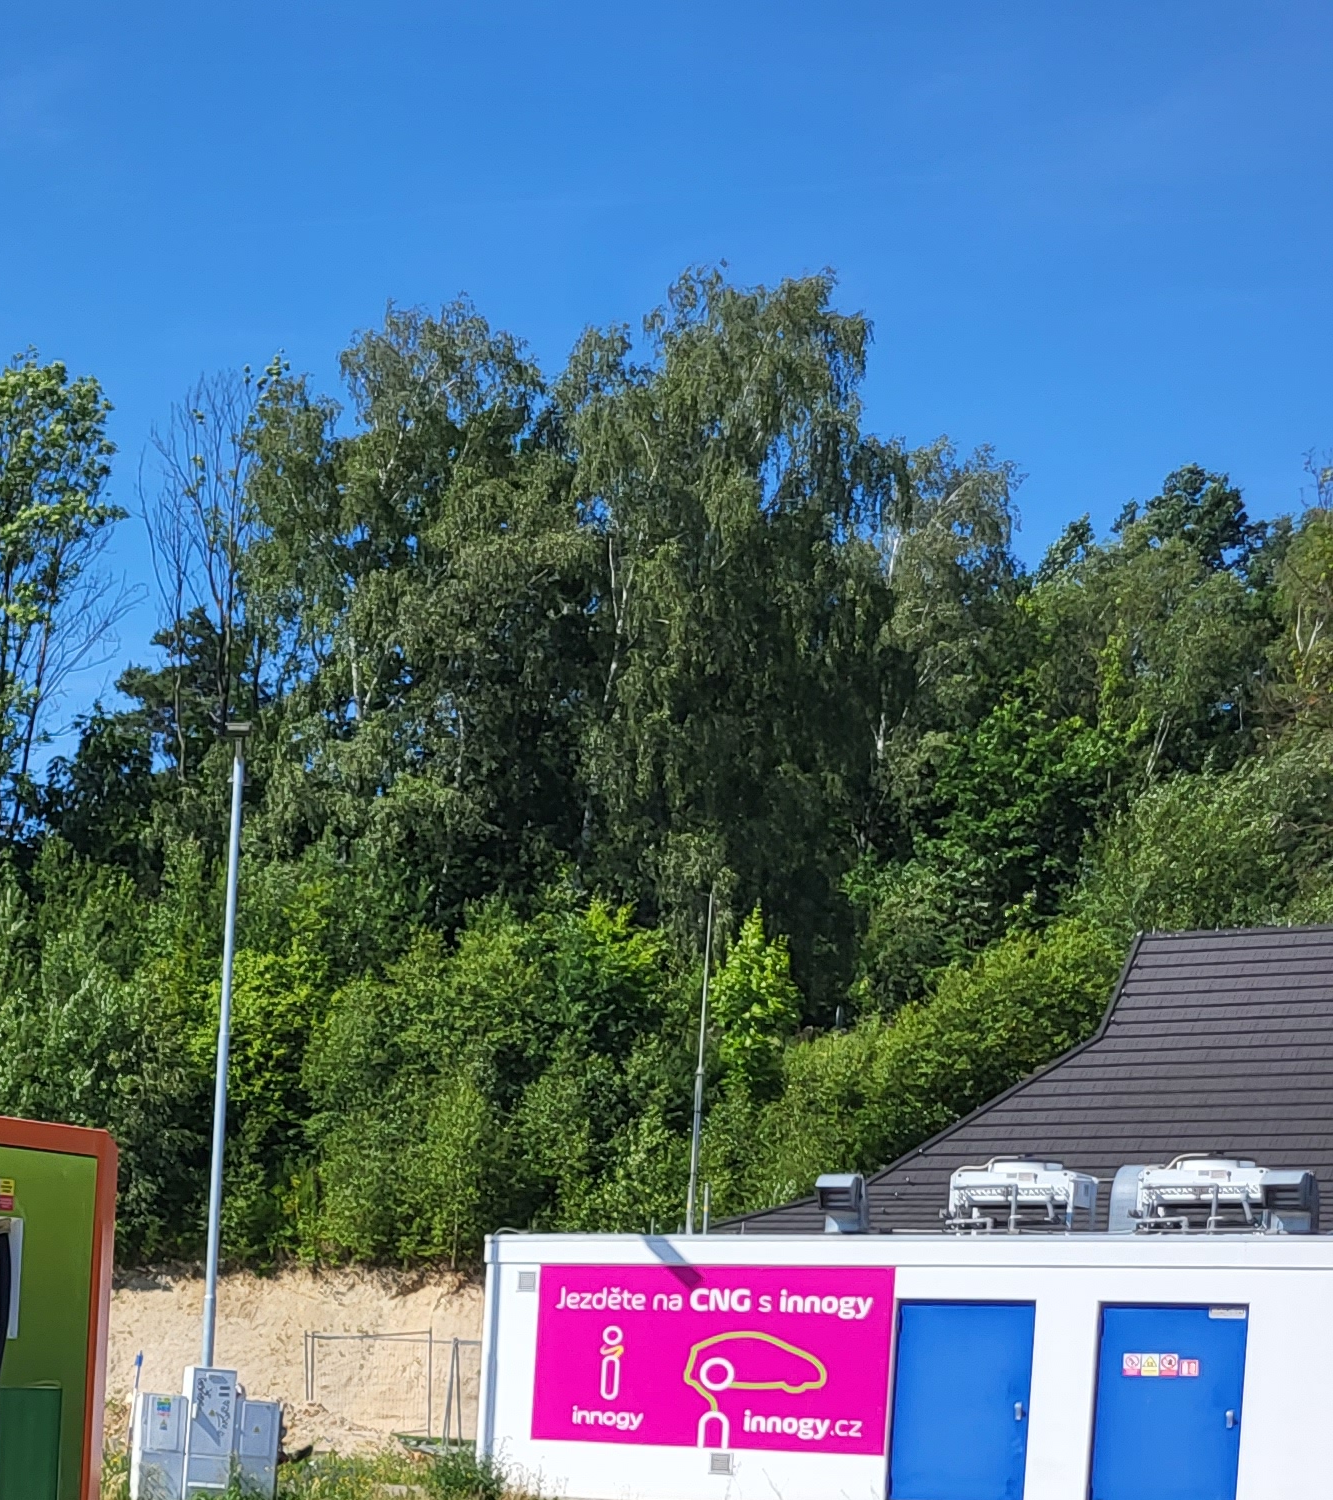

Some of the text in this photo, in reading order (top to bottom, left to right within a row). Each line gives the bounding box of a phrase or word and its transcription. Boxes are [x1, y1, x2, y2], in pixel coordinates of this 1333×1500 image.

[555, 1287, 874, 1320] Jezděte na CNG s innogy
[572, 1405, 644, 1430] innogy
[743, 1409, 863, 1440] innogy.cz
